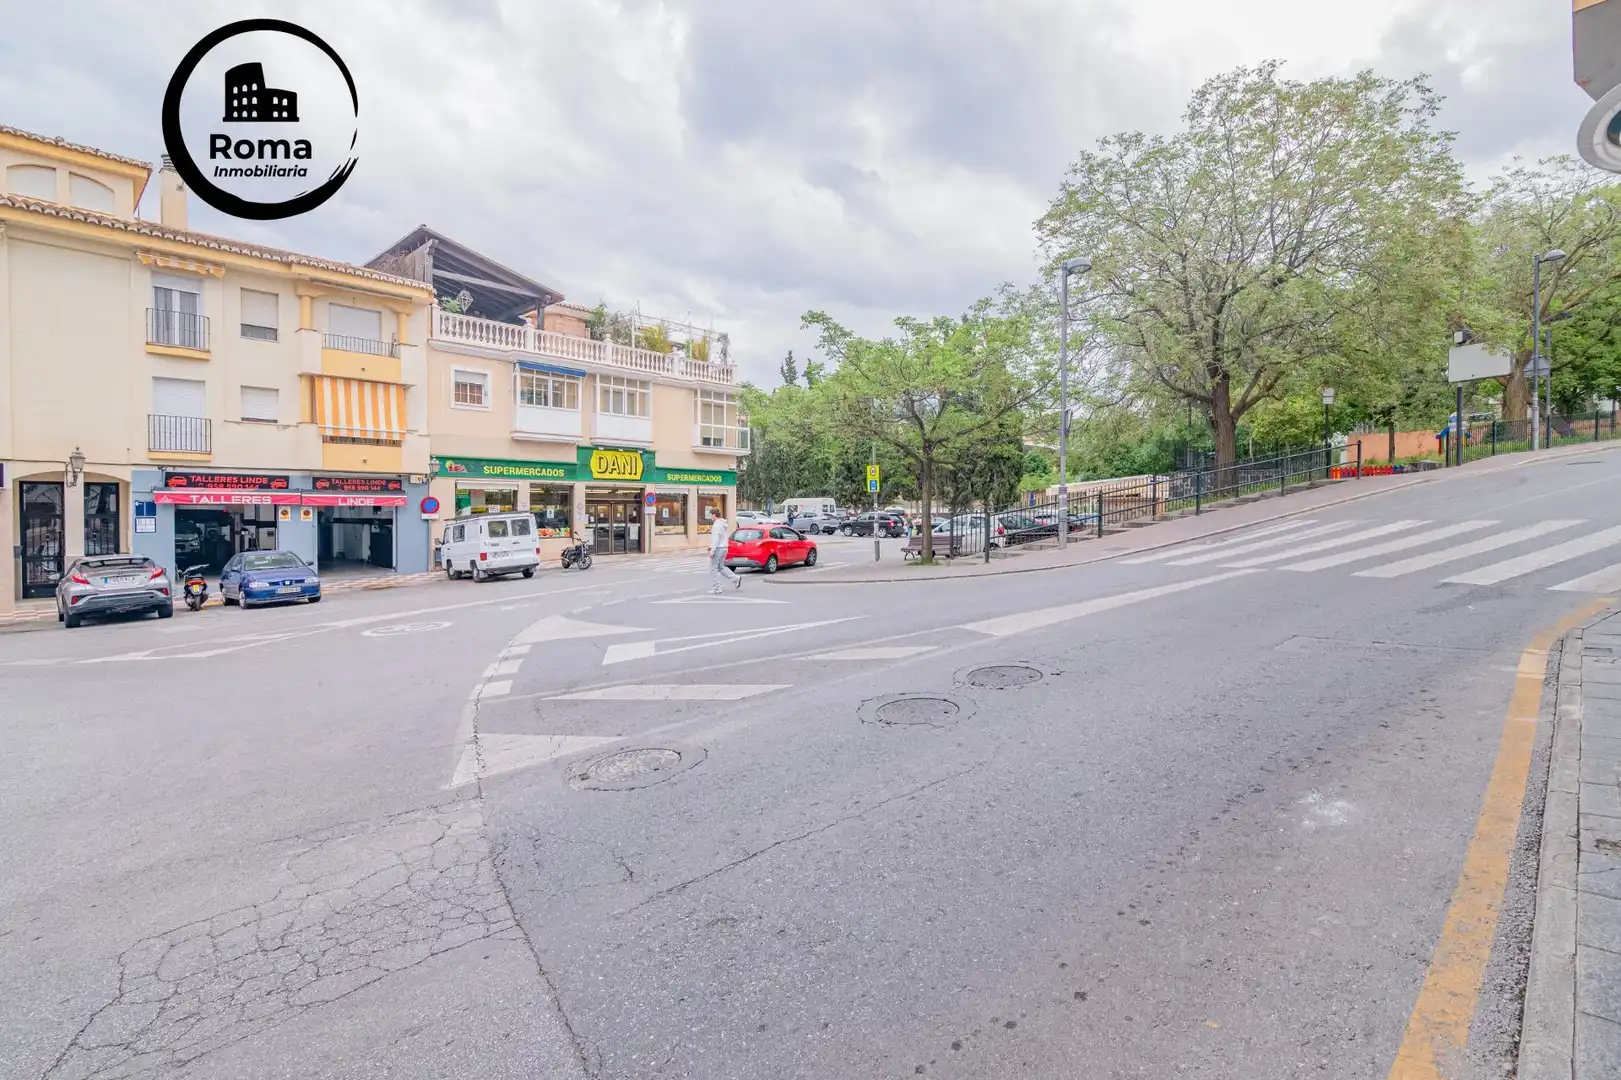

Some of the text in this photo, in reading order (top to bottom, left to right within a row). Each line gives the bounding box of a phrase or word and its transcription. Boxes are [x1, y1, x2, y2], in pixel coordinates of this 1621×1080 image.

[596, 454, 638, 476] DANI
[483, 465, 565, 477] SUPERMERCADOS
[189, 475, 269, 484] TALLERES LINDE
[331, 478, 365, 486] TALLERES
[666, 473, 722, 483] SUPERMERCADOS
[189, 495, 272, 504] TALLERES
[338, 497, 376, 506] LINDE
